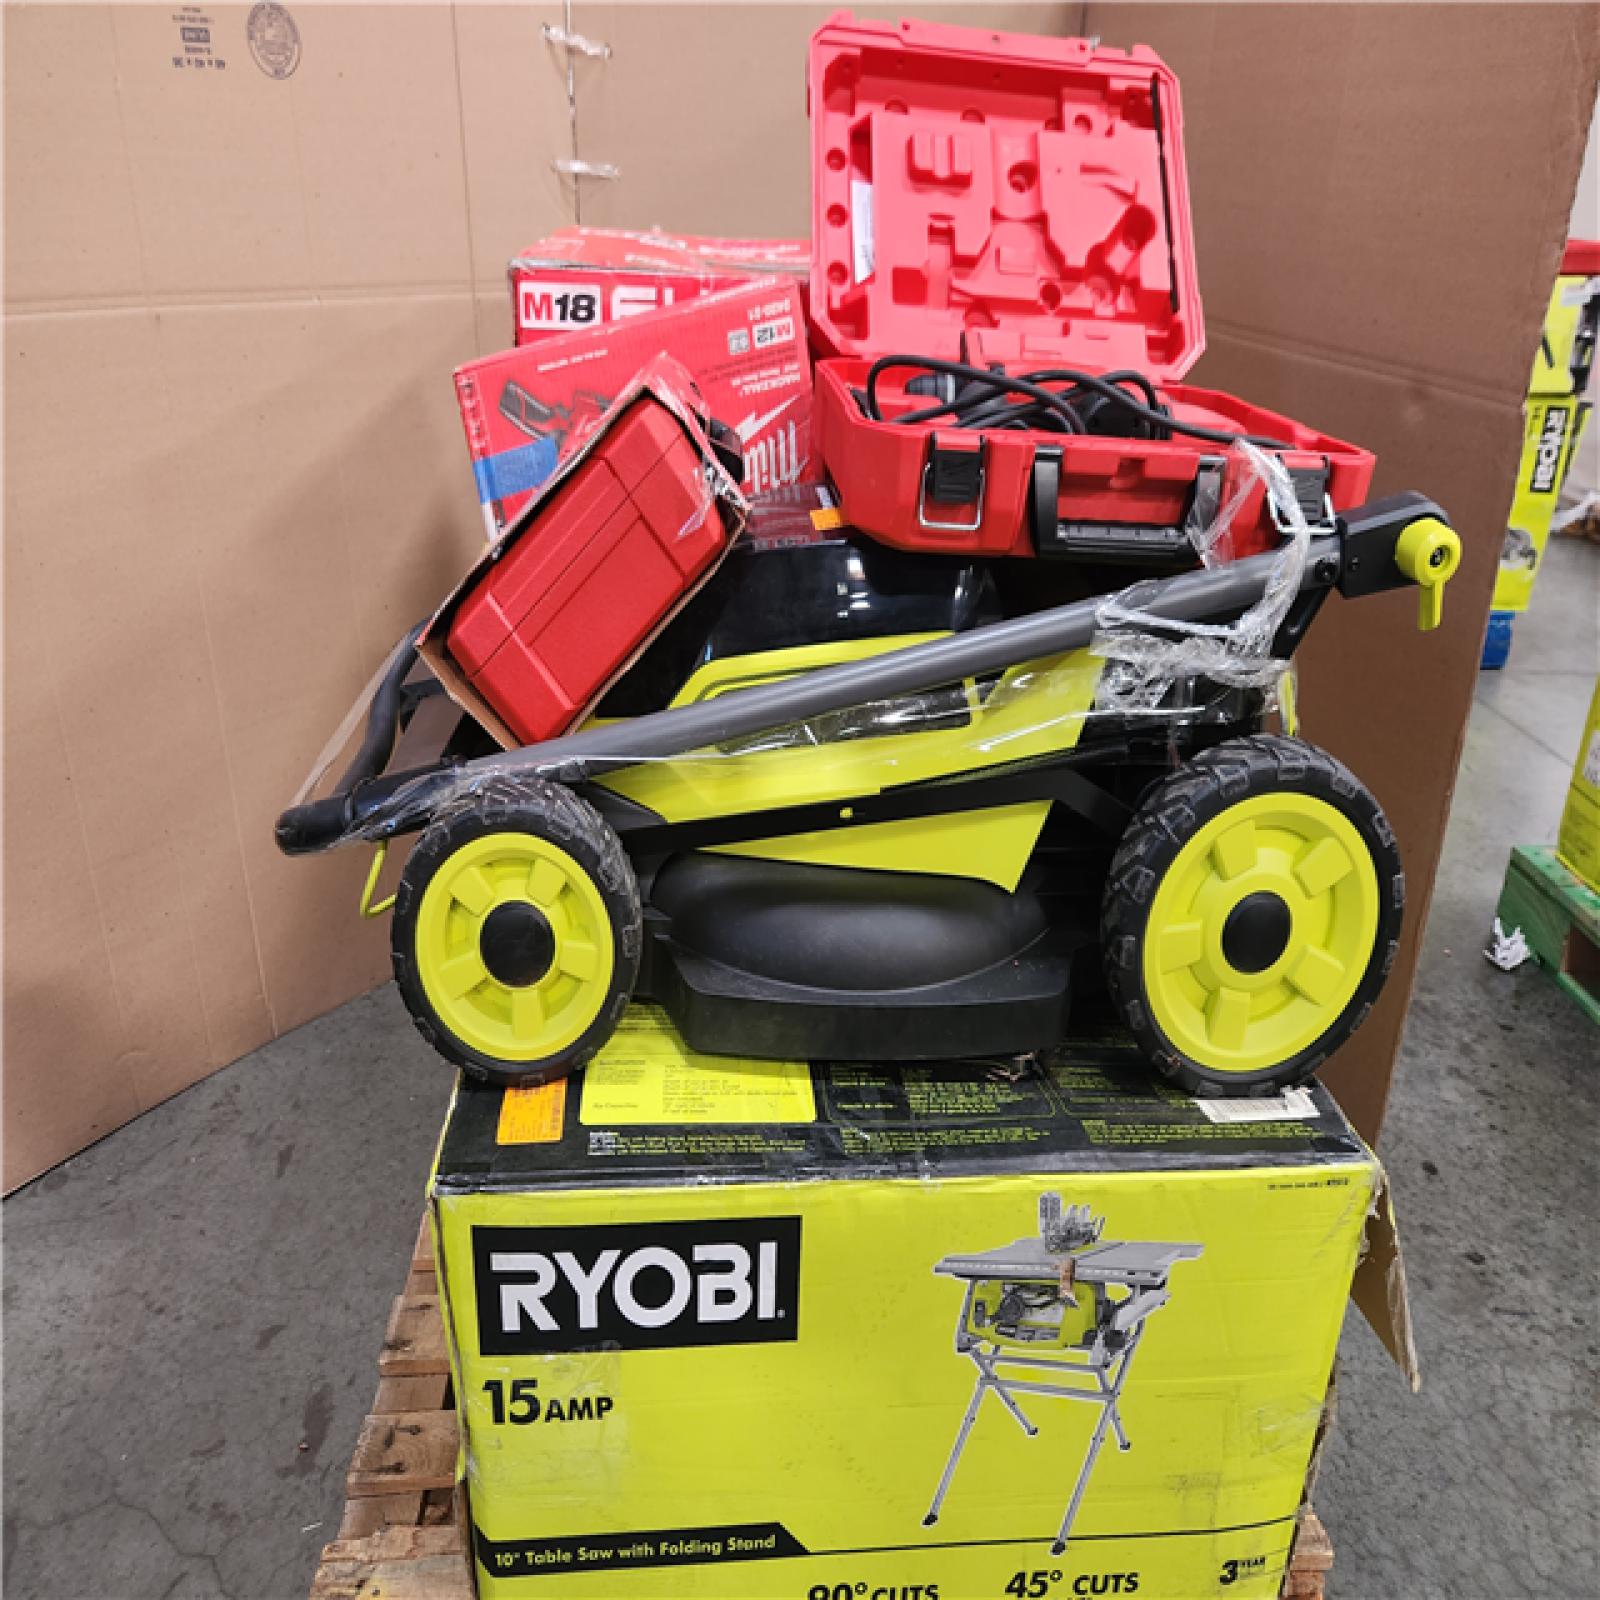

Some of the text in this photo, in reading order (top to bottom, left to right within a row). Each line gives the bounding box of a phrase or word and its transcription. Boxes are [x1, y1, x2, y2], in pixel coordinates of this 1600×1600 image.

[524, 292, 596, 323] M18
[489, 1241, 779, 1333] RYOBI
[526, 1550, 571, 1566] Table
[577, 1547, 613, 1561] Saw
[618, 1543, 654, 1559] with
[659, 1539, 721, 1556] Folding
[727, 1534, 776, 1551] Stand
[1004, 1570, 1139, 1599] 45° CUTS
[1219, 1559, 1238, 1585] 3
